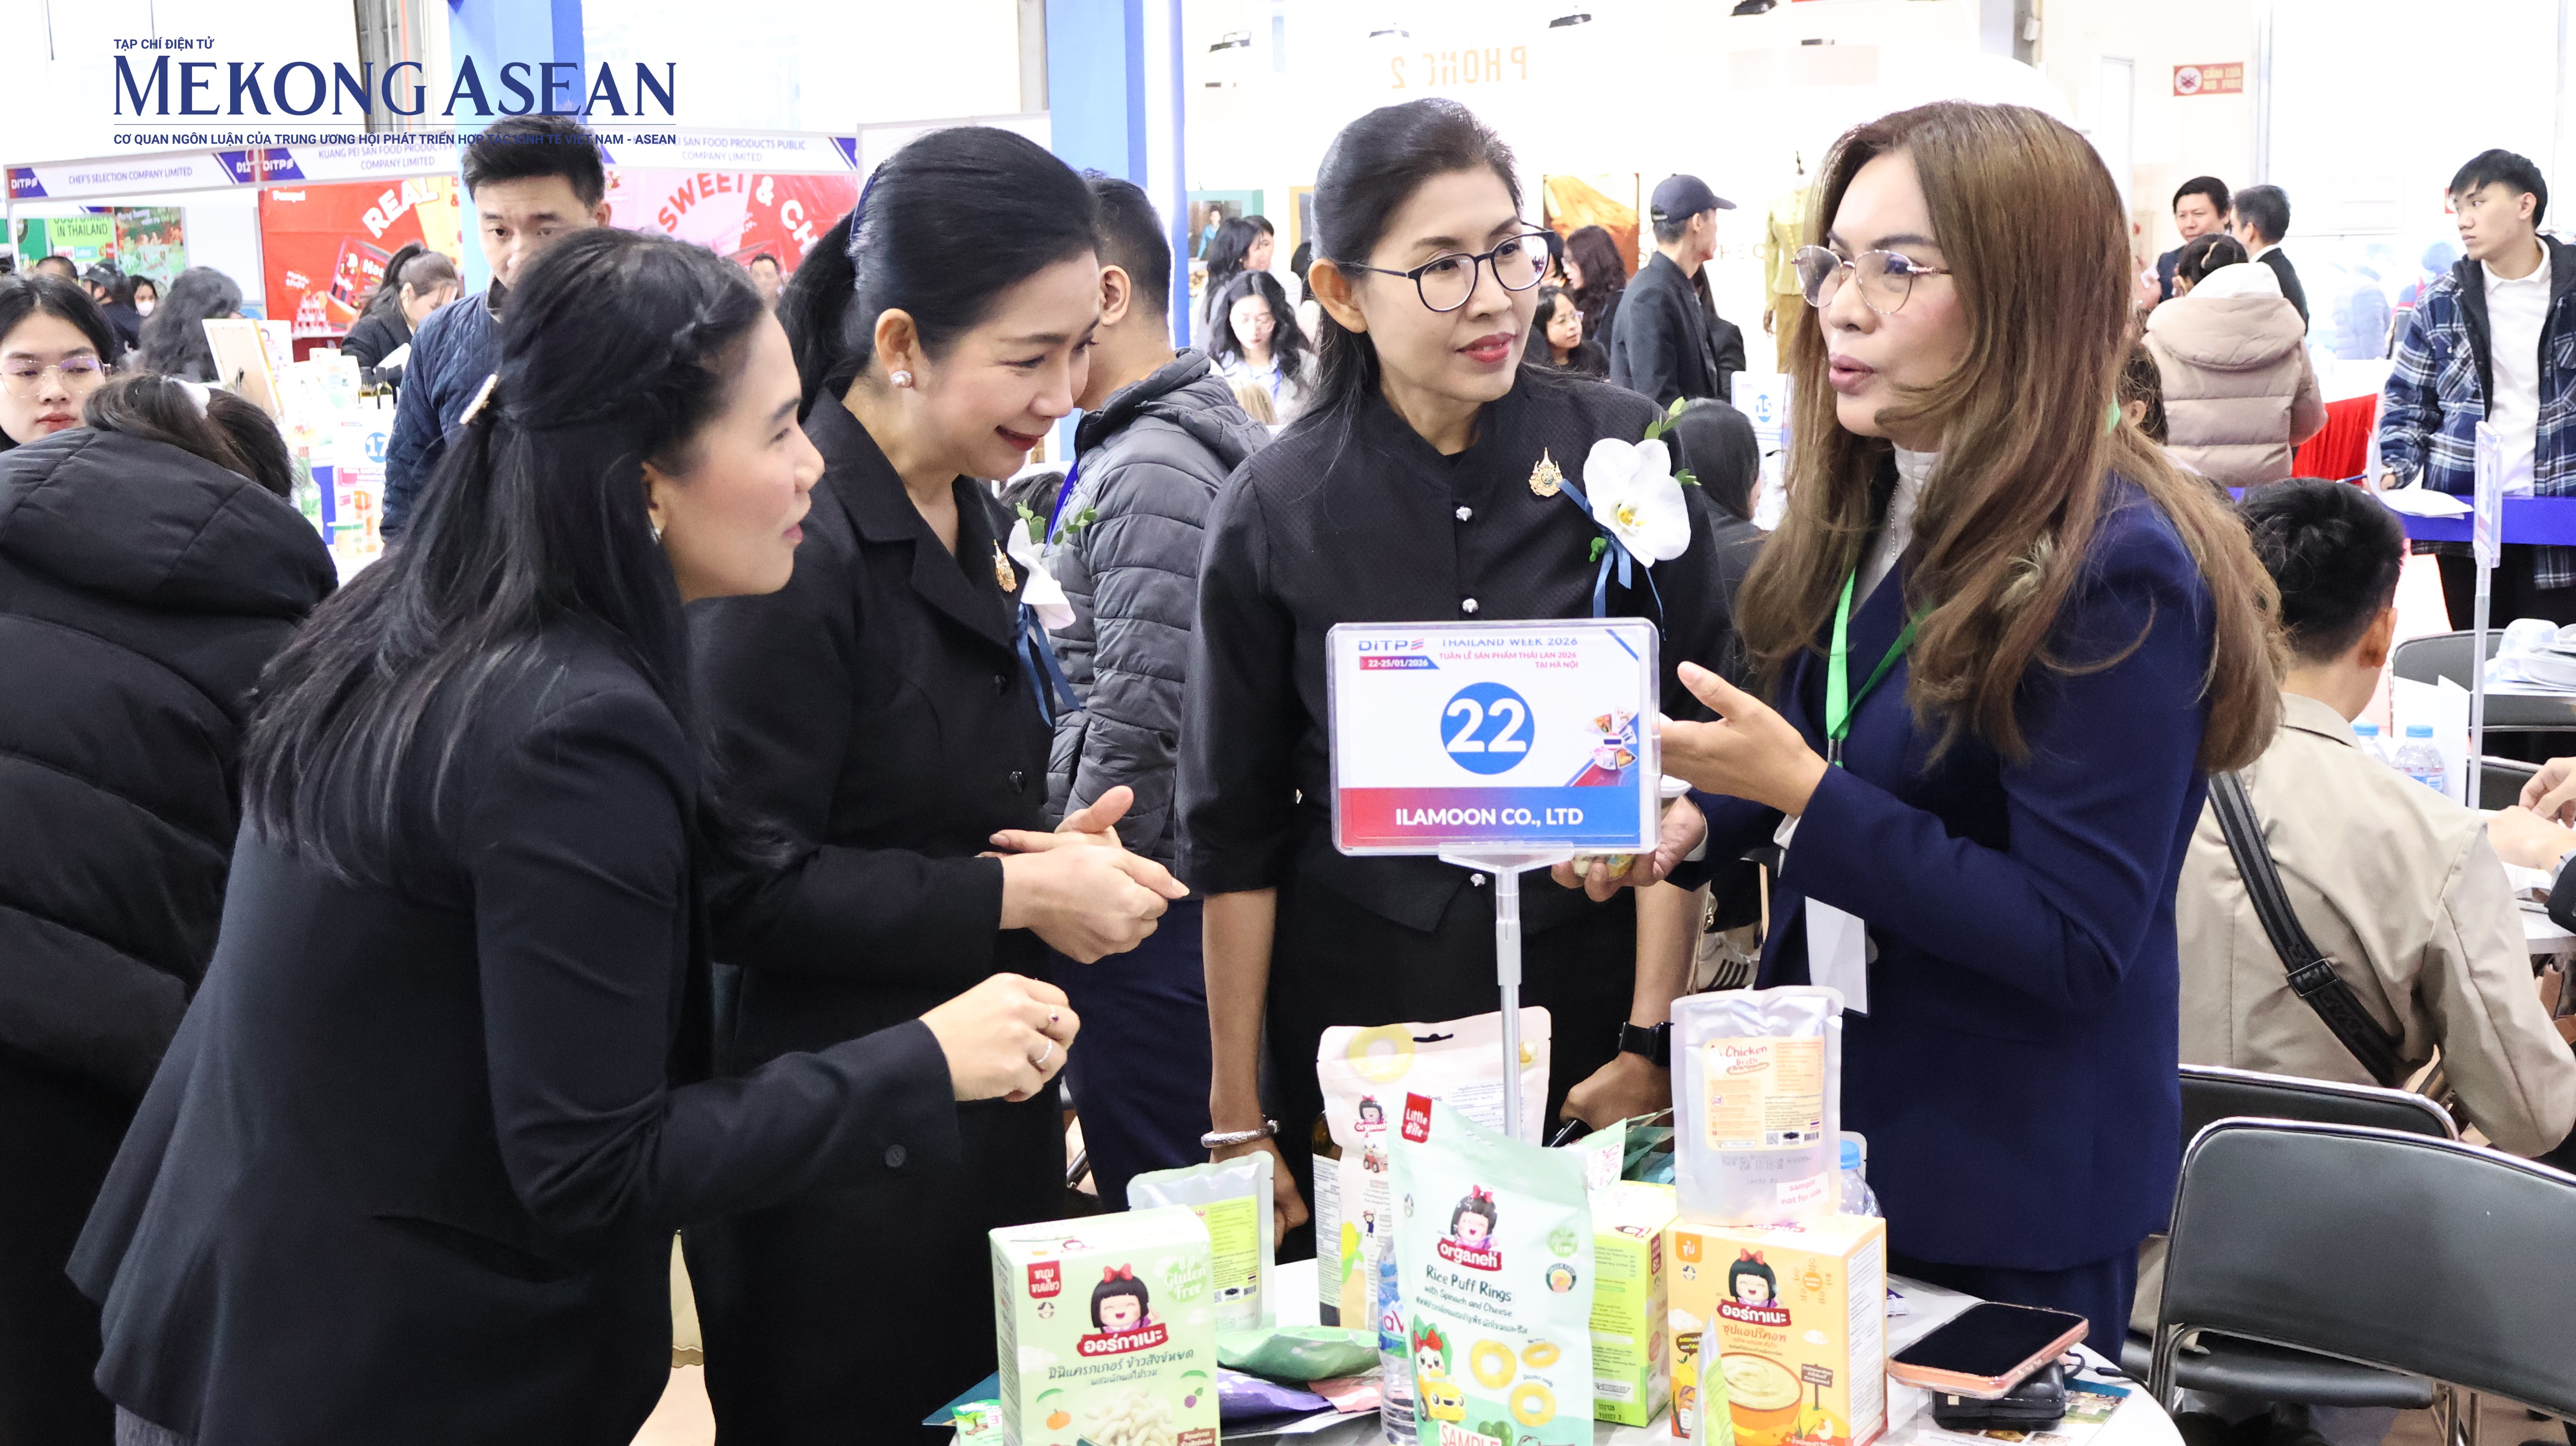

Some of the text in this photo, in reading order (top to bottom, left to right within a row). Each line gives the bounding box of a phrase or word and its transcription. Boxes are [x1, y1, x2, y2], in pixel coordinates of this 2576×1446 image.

[683, 137, 700, 146] SAN
[703, 137, 728, 147] FOOD
[731, 139, 775, 149] PRODUCTS
[778, 140, 805, 150] PUBLIC
[319, 148, 346, 159] KUANG
[348, 147, 360, 157] PEI
[362, 146, 377, 157] SAN
[379, 145, 402, 155] FOOD
[682, 152, 762, 162] COMPANY LIMITED
[361, 156, 435, 170] COMPANY LIMITED
[92, 172, 127, 183] SELECTION
[129, 170, 164, 181] COMPANY
[164, 167, 193, 178] LIMITED
[756, 176, 775, 207] &
[361, 177, 439, 239] REAL
[57, 223, 107, 238] IN THAILAND
[1756, 398, 1772, 417] 15
[366, 436, 388, 457] 17
[1443, 637, 1578, 647] THAILAND WEEK 2026
[1368, 659, 1429, 668] 22-25/01/2026
[1446, 698, 1527, 753] 22
[1396, 807, 1583, 827] ILAMOON CO., LTD
[1725, 1045, 1768, 1057] Chicken
[1736, 1057, 1758, 1066] Broth
[1406, 1108, 1428, 1125] Little
[1405, 1122, 1424, 1137] Bite
[1789, 1179, 1816, 1191] sample
[1798, 1194, 1808, 1202] for
[1810, 1188, 1822, 1198] sale
[1164, 1265, 1207, 1292] Gluten
[1426, 1264, 1512, 1302] Rice Puff Rings
[1173, 1282, 1202, 1300] Free
[1425, 1285, 1512, 1317] with Spinach and Cheese
[1722, 1305, 1787, 1323] ออร์กาเนะ
[1084, 1330, 1163, 1353] ออร์กาเนะ
